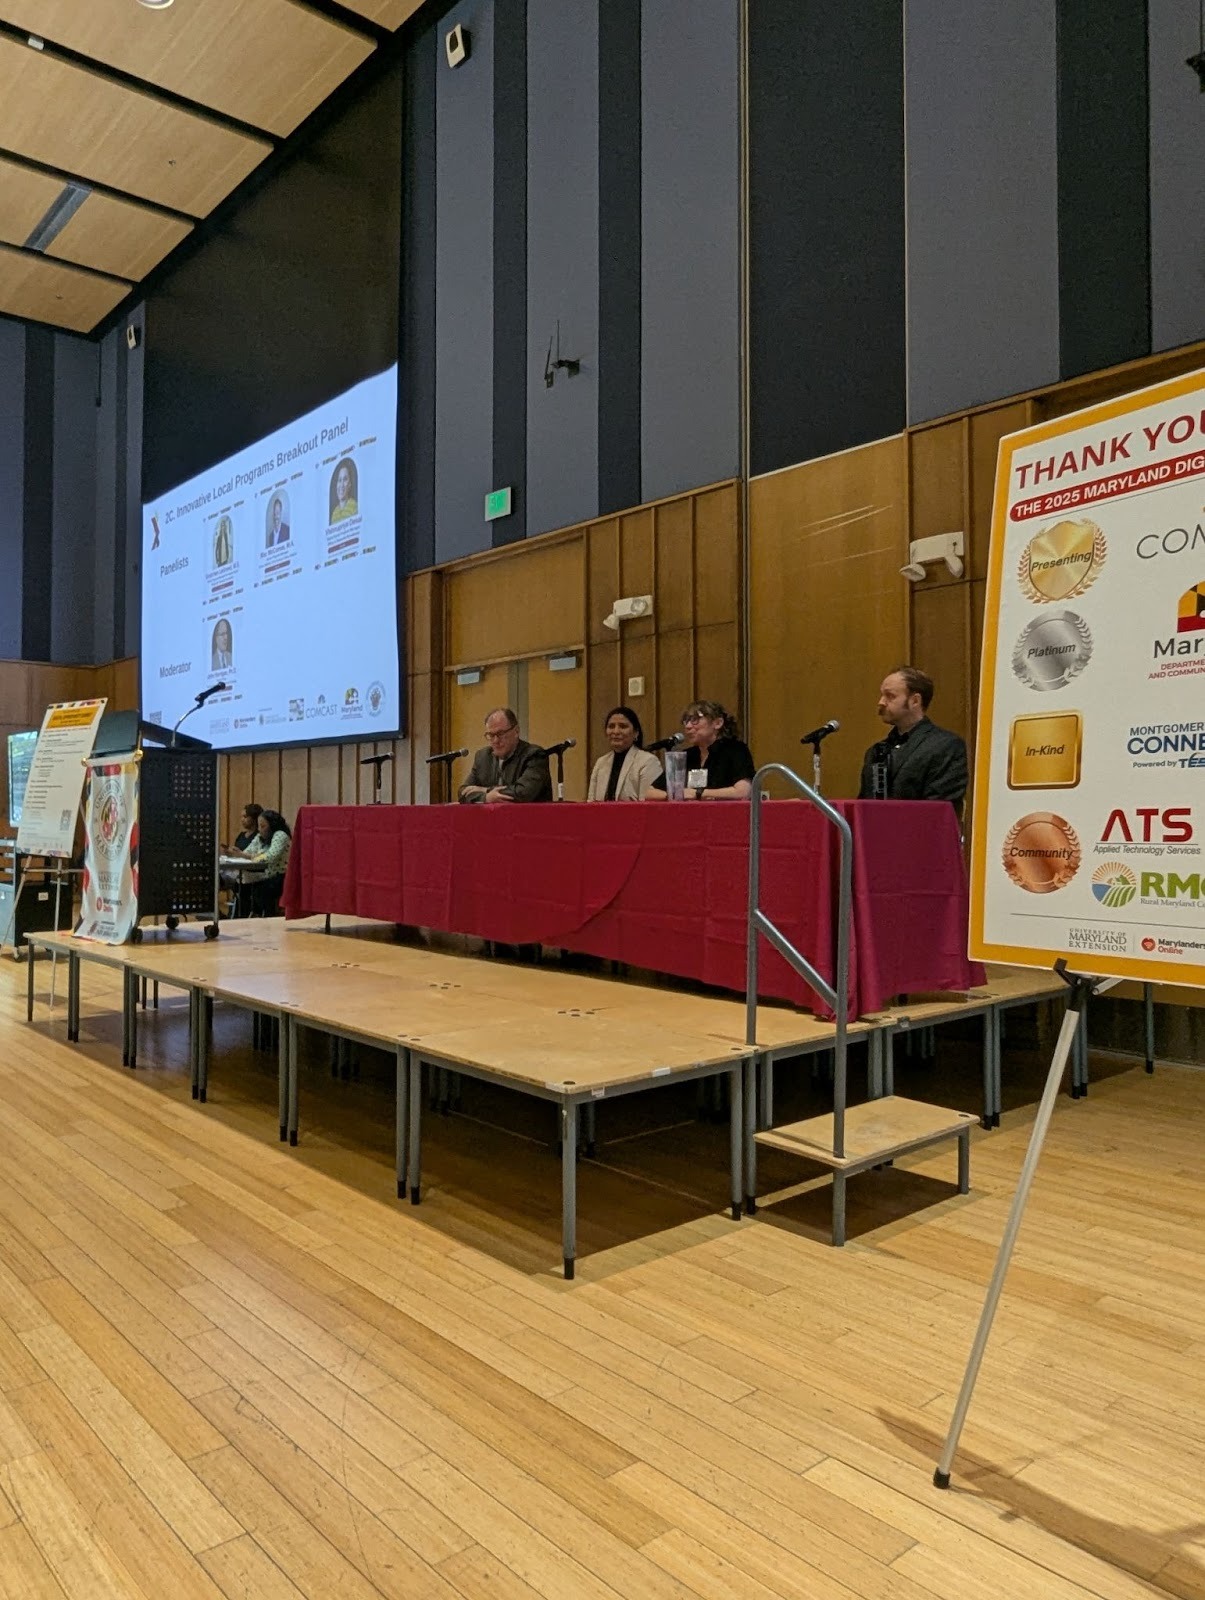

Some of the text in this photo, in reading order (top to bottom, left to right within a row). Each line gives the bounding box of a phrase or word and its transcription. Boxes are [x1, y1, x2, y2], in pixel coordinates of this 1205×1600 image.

[176, 492, 212, 517] Innovative
[213, 481, 234, 498] Local
[235, 458, 275, 490] Programs
[277, 434, 319, 466] Breakout
[320, 416, 350, 445] Panel
[1015, 432, 1133, 490] THANK
[1015, 455, 1205, 518] THE 2025 MARYLAND DIG
[160, 557, 189, 578] Panelists
[1030, 551, 1093, 573] Presenting
[1027, 643, 1076, 659] Platinum
[159, 662, 192, 679] Moderator
[1148, 671, 1167, 680] AND
[305, 703, 338, 719] COMCAST
[1129, 722, 1205, 736] MONTGOMER
[1025, 743, 1065, 757] In-Kind
[1132, 760, 1166, 768] Powered
[1167, 760, 1178, 768] by
[1100, 808, 1194, 843] ATS
[1009, 847, 1074, 861] Community
[1093, 845, 1201, 857] Applied Technology Services
[1140, 871, 1205, 900] RM
[1160, 899, 1196, 908] Maryland
[1069, 928, 1116, 936] UNIVERSITY
[1069, 932, 1127, 945] MARYLAND
[1068, 941, 1127, 952] EXTENSION
[1158, 945, 1184, 955] Online
